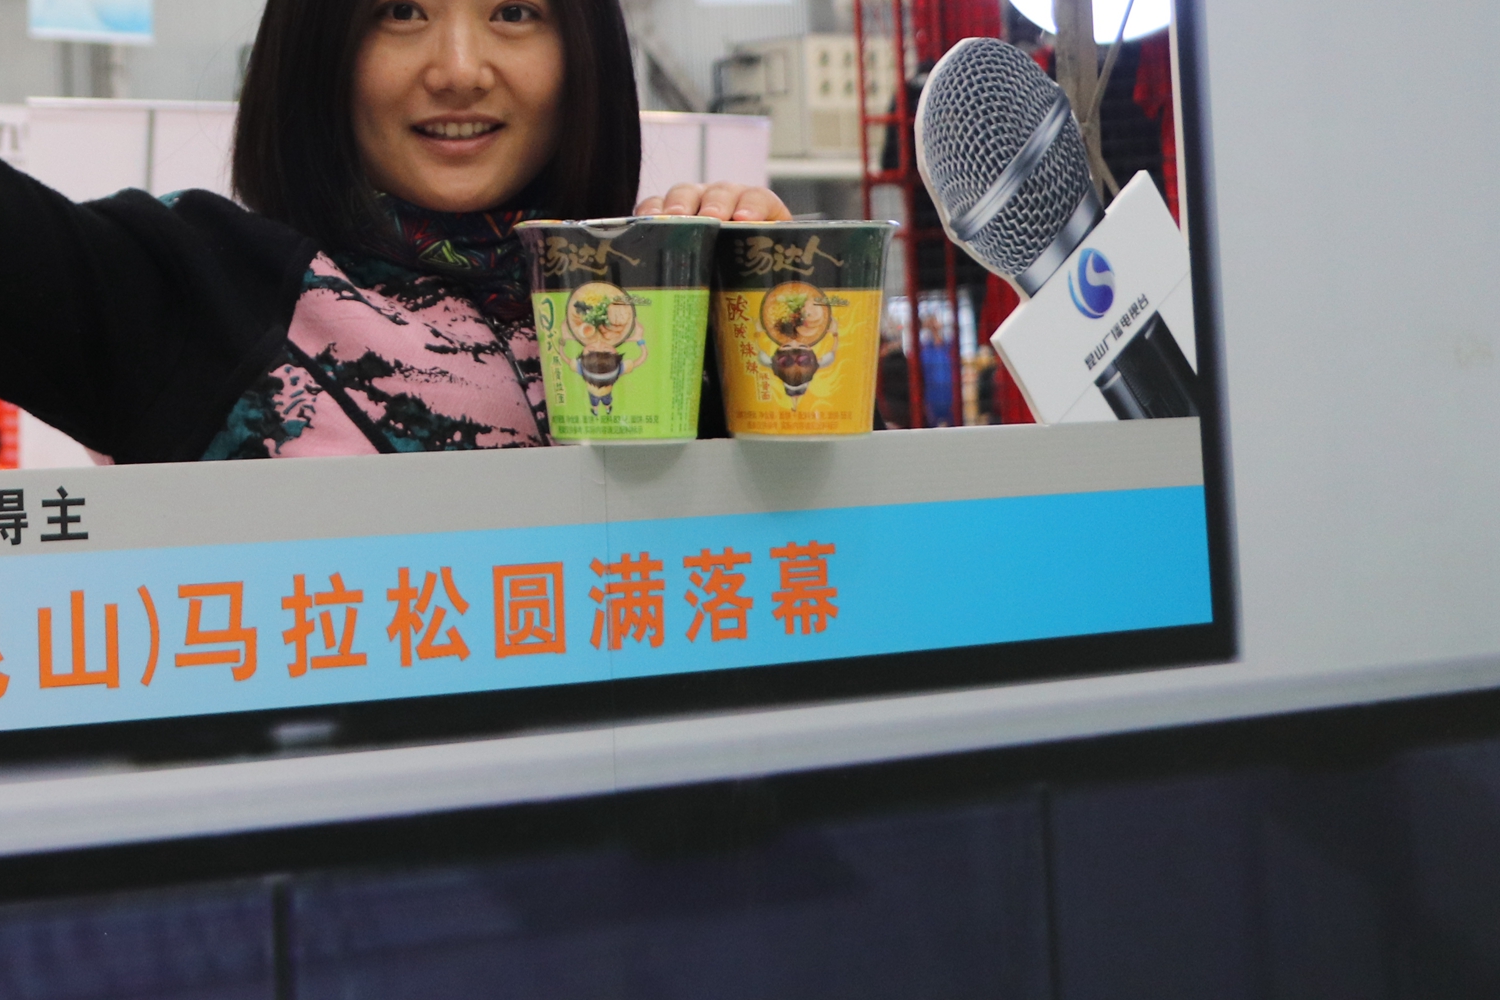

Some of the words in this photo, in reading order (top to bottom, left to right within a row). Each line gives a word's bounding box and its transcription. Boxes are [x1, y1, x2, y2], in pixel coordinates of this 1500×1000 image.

[538, 236, 641, 275] 汤达人
[734, 235, 844, 276] 汤达人
[1084, 293, 1150, 371] 昆山广播电视台
